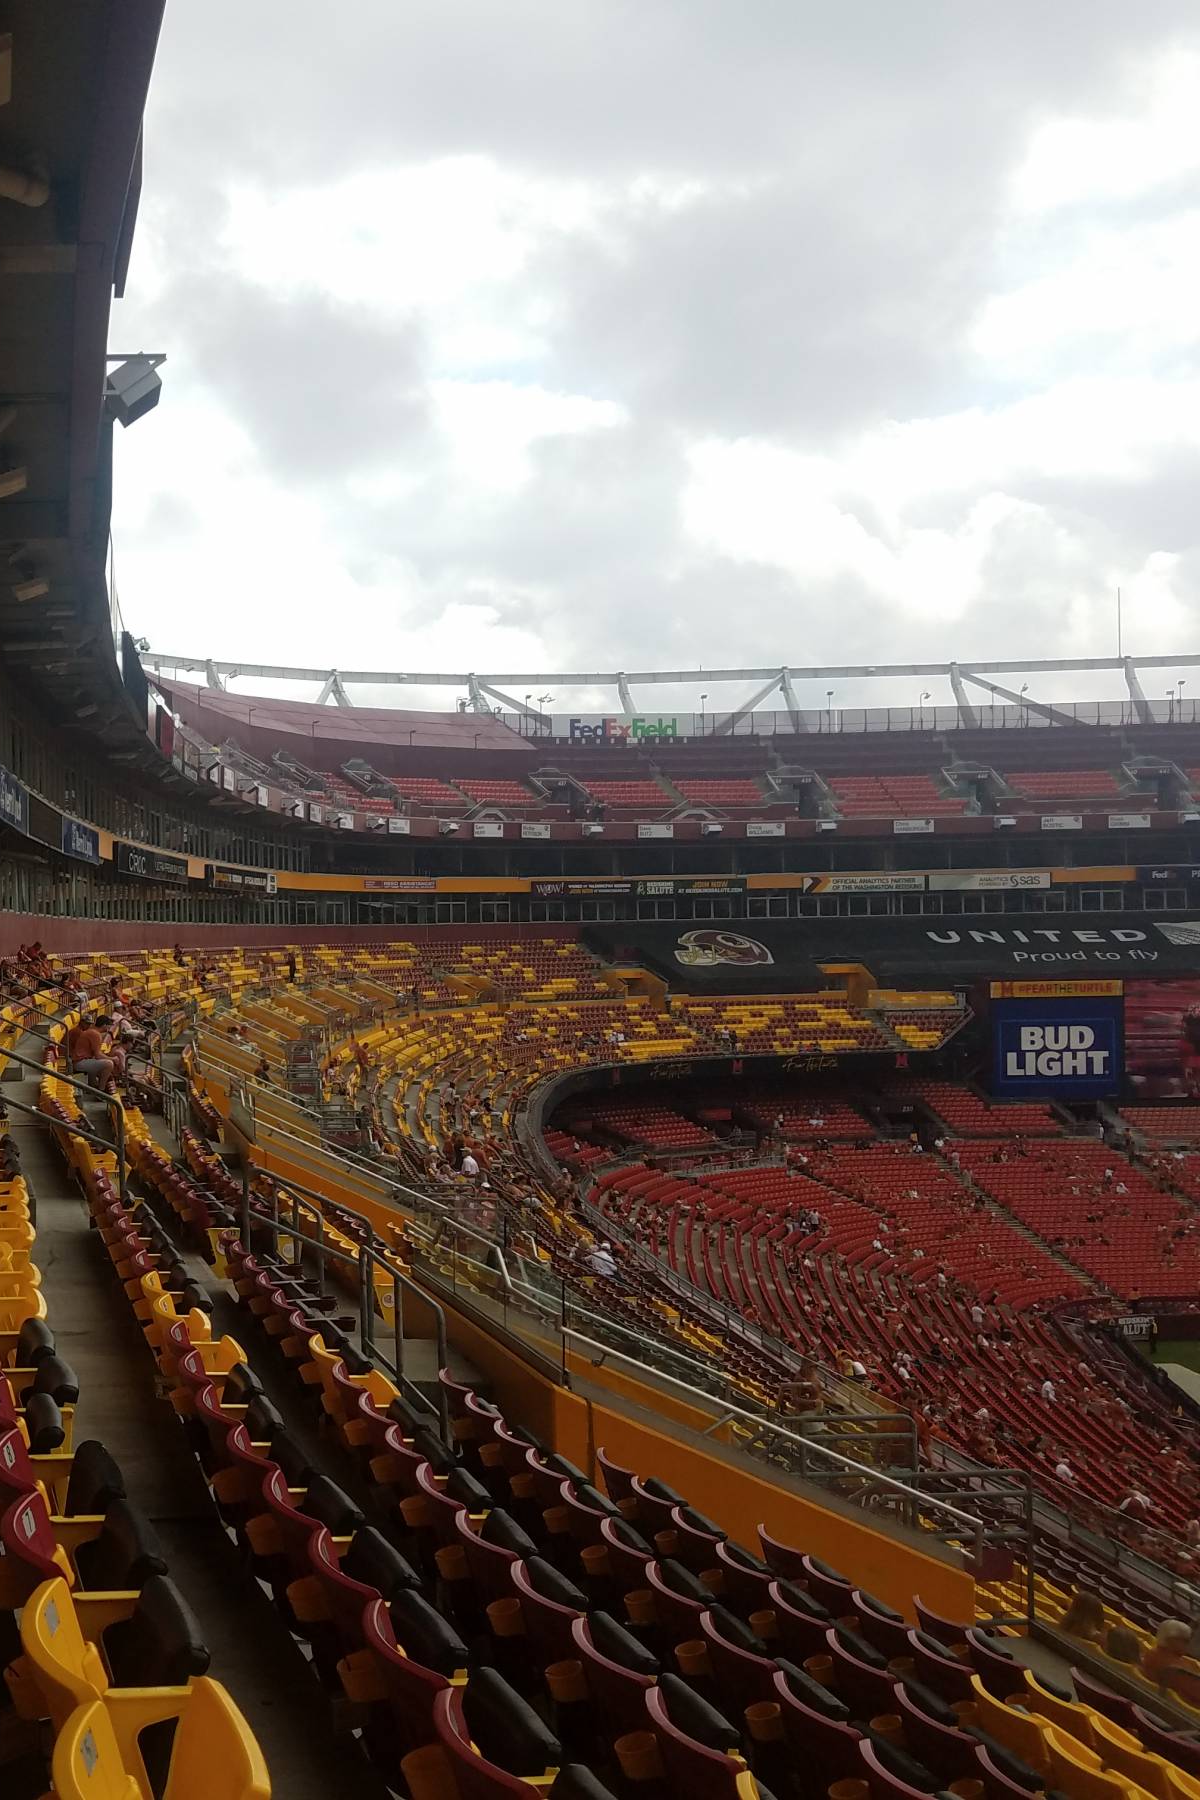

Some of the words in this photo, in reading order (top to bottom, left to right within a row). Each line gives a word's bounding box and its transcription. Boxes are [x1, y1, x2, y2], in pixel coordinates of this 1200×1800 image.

[926, 928, 1147, 944] UNITED
[1013, 950, 1087, 963] Proud
[1095, 950, 1121, 960] to
[1129, 950, 1159, 961] fly
[1021, 1025, 1095, 1050] BUD
[1006, 1050, 1109, 1077] LIGHT
